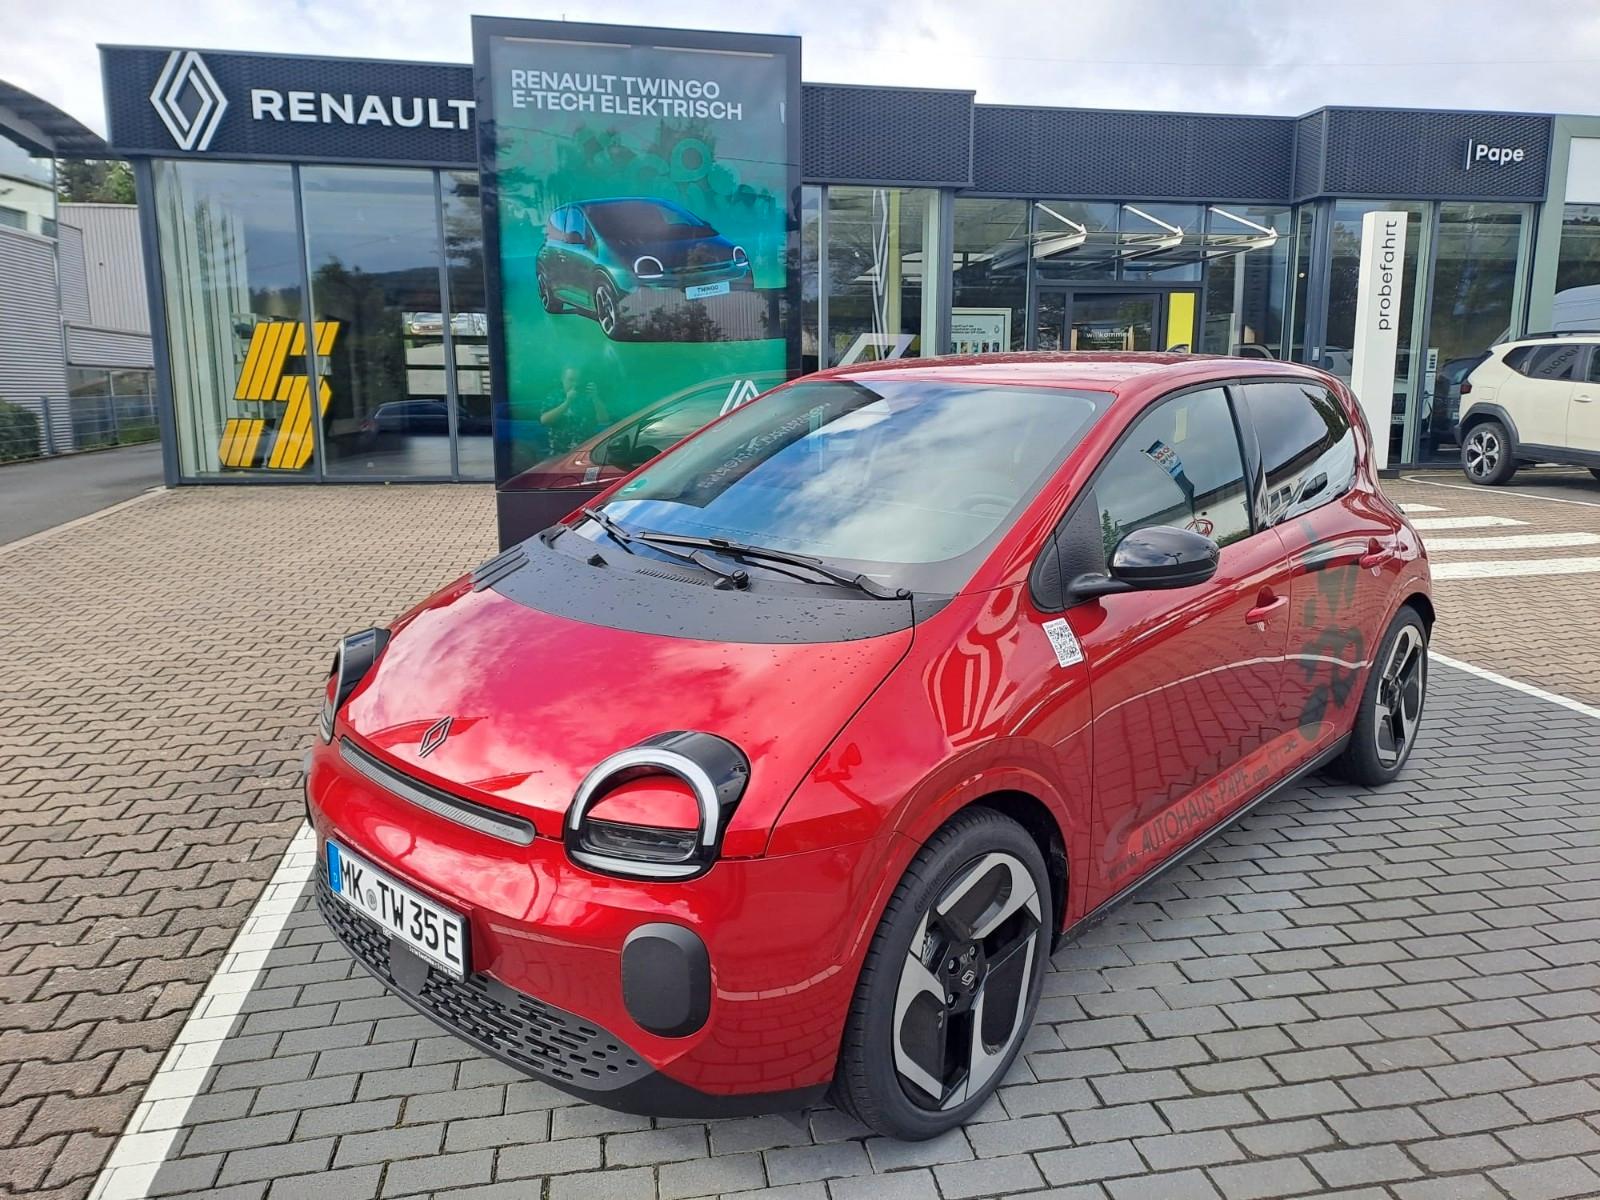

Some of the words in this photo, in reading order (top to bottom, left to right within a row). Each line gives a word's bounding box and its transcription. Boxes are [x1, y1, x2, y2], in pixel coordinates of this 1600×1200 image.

[511, 70, 617, 93] RENAULT
[621, 76, 720, 99] TWINGO
[251, 89, 476, 129] RENAULT
[511, 90, 596, 112] E-TECH
[601, 95, 743, 120] ELEKTRISCH
[1476, 144, 1525, 165] Pape
[1378, 221, 1397, 330] probefahrt
[339, 854, 365, 906] MK
[377, 880, 404, 931] TW
